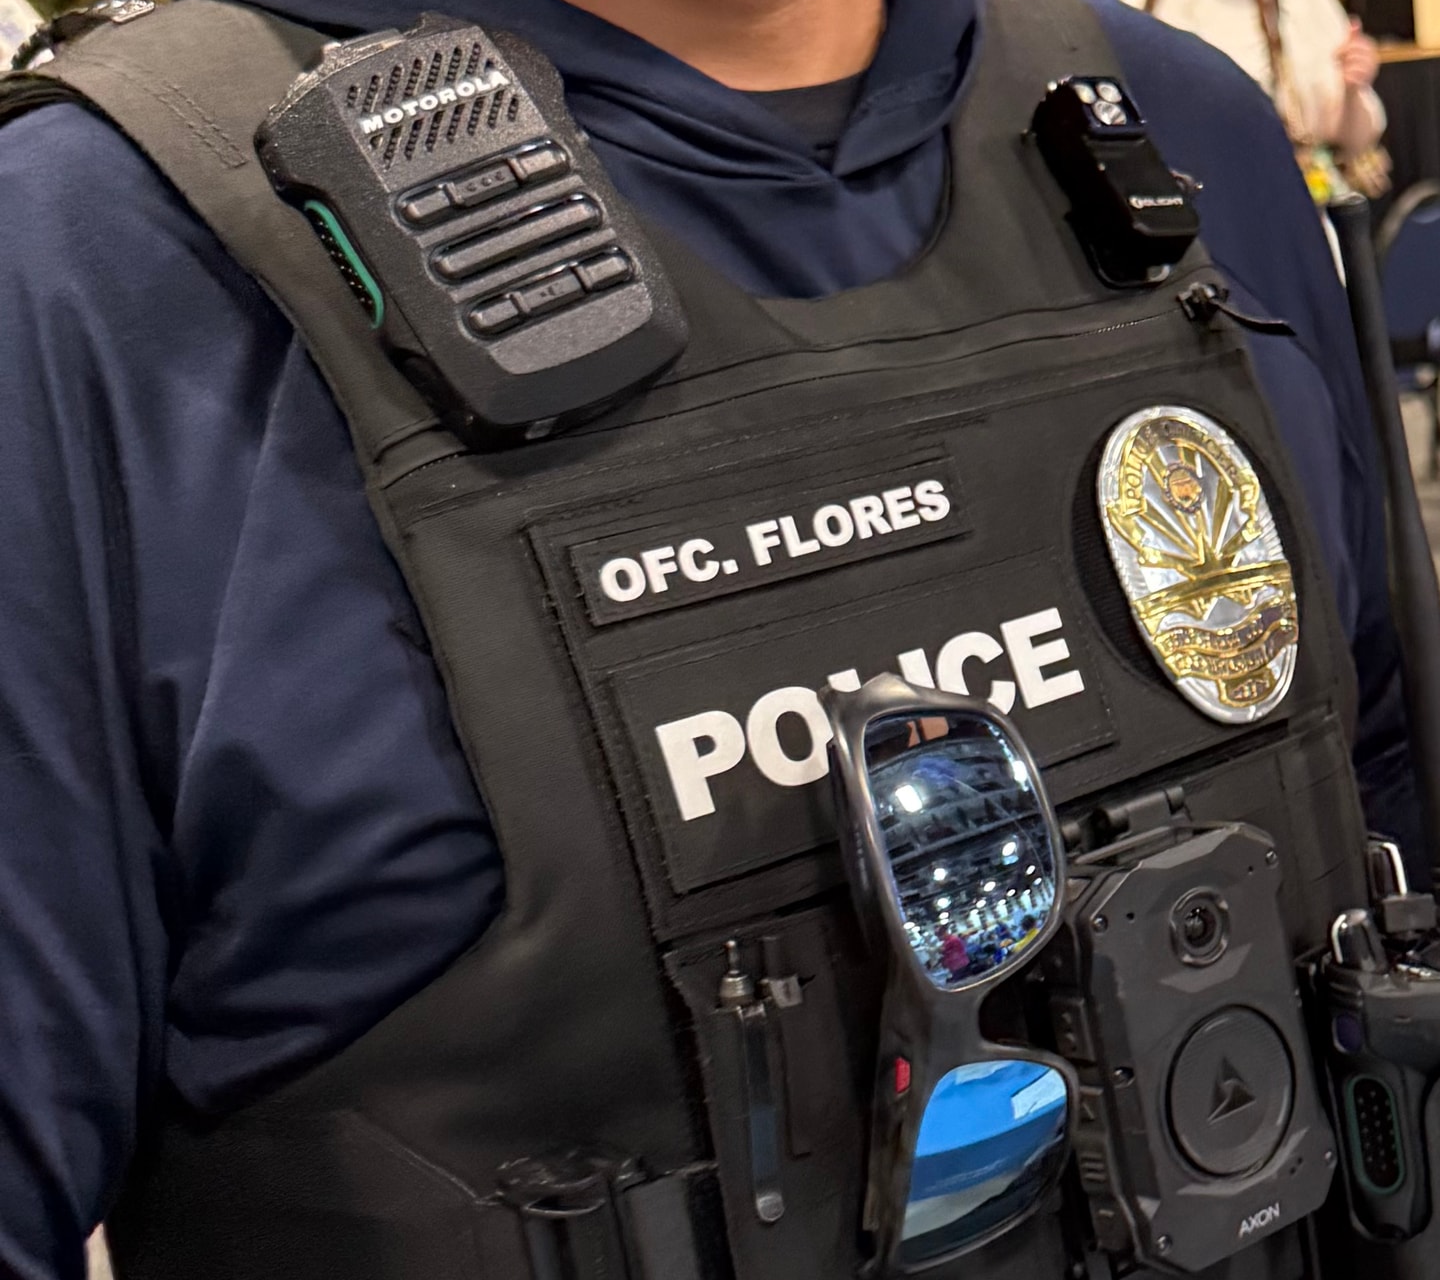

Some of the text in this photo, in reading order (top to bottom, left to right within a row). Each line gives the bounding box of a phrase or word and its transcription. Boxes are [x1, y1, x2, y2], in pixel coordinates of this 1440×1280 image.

[360, 71, 511, 135] MOTOROLA
[598, 480, 951, 602] OFC. FLORES
[655, 607, 1085, 822] POCE
[1238, 1202, 1280, 1238] AXON
